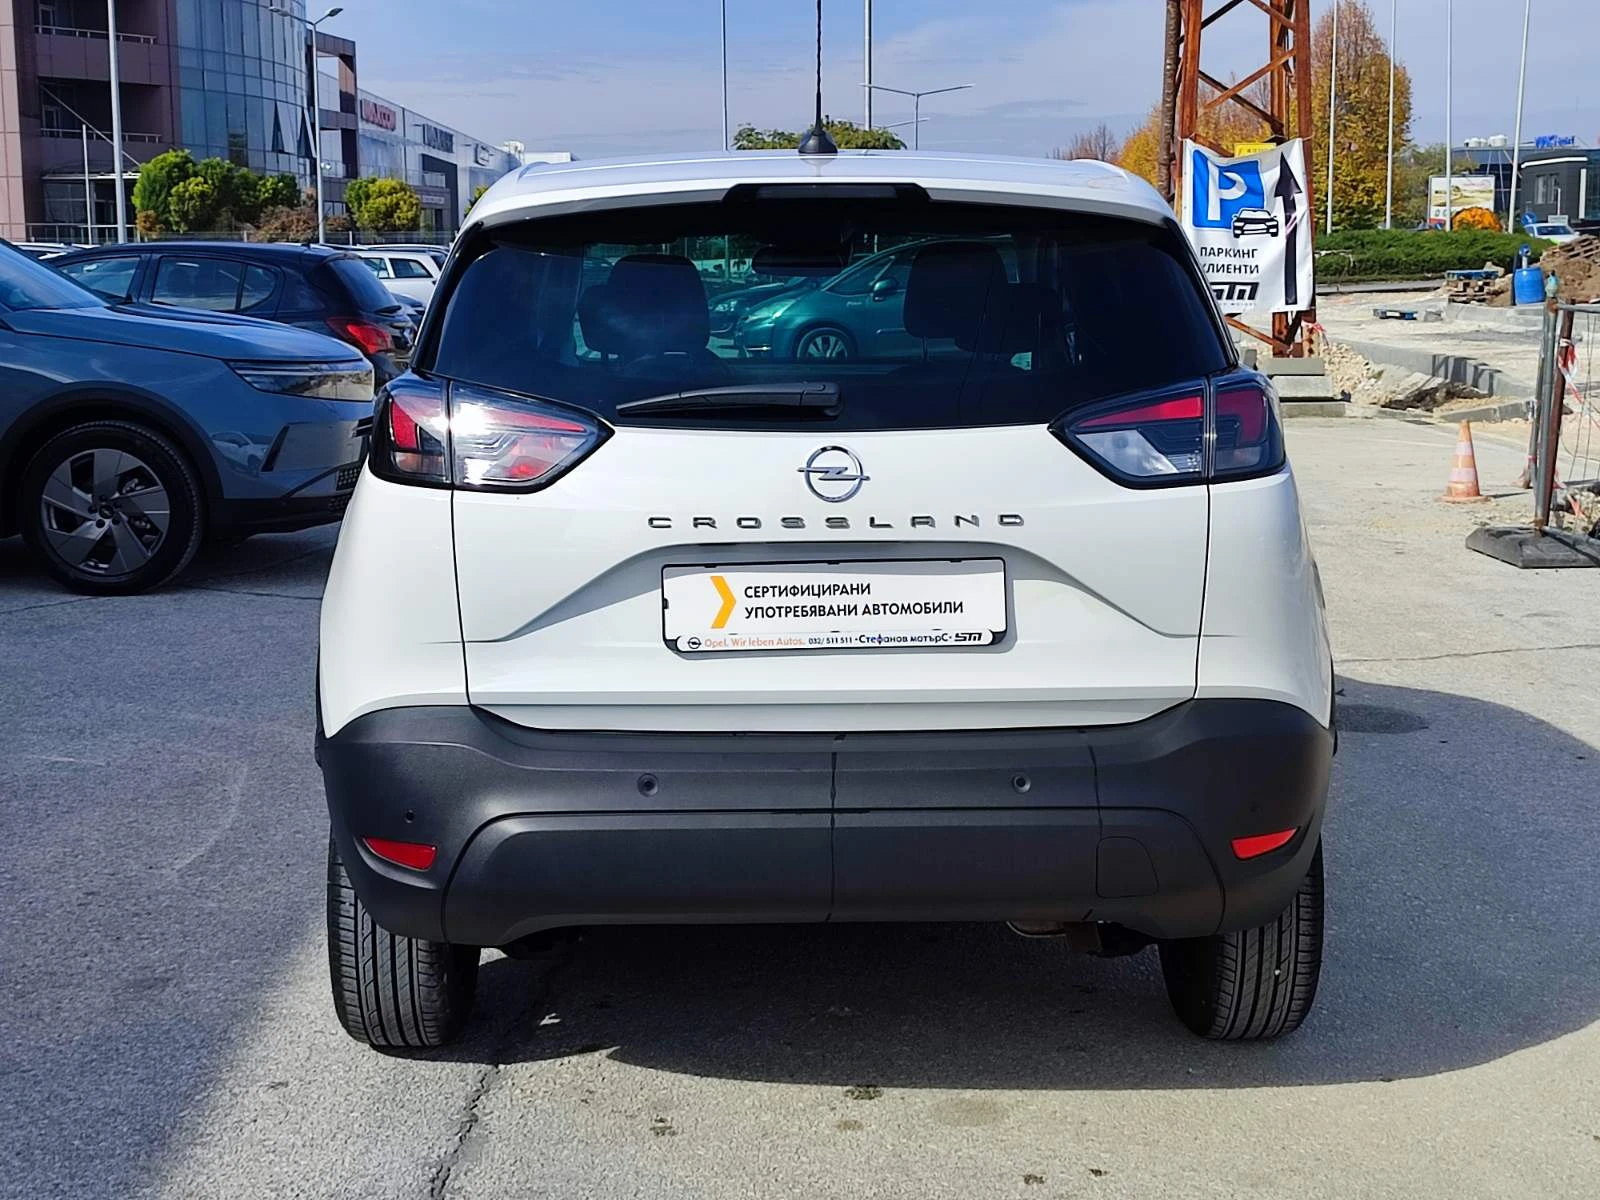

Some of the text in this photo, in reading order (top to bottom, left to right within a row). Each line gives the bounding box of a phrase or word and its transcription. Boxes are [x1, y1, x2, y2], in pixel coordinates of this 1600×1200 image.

[1207, 160, 1248, 221] P
[1200, 246, 1258, 259] ПАРКИНГ
[647, 514, 1025, 529] CROSSLAND
[744, 583, 871, 599] СЕРТИФИЦИРАНИ
[745, 601, 964, 619] УПОТРЕБЯВАНИ АВТОМОБИЛИ
[704, 638, 728, 649] Opel.
[731, 637, 747, 646] Wir
[749, 636, 774, 646] leben
